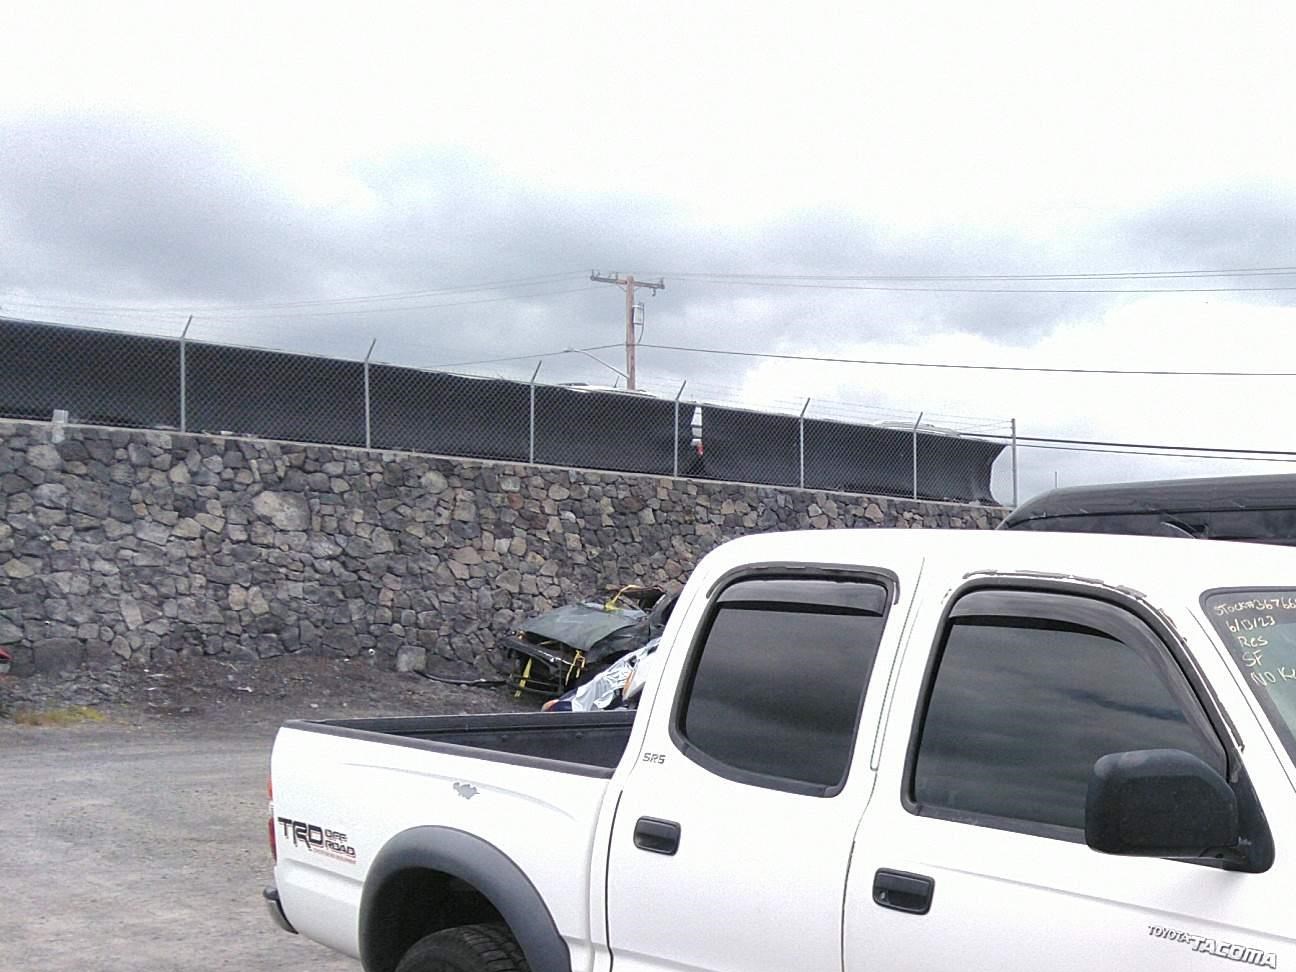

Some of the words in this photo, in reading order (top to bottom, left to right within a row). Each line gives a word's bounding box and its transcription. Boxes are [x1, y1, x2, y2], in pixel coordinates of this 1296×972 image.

[277, 816, 324, 851] TRD
[324, 828, 348, 843] OFF
[324, 840, 357, 858] ROAD
[1148, 925, 1192, 944] TOYOTA
[1191, 935, 1278, 970] TACOMA
